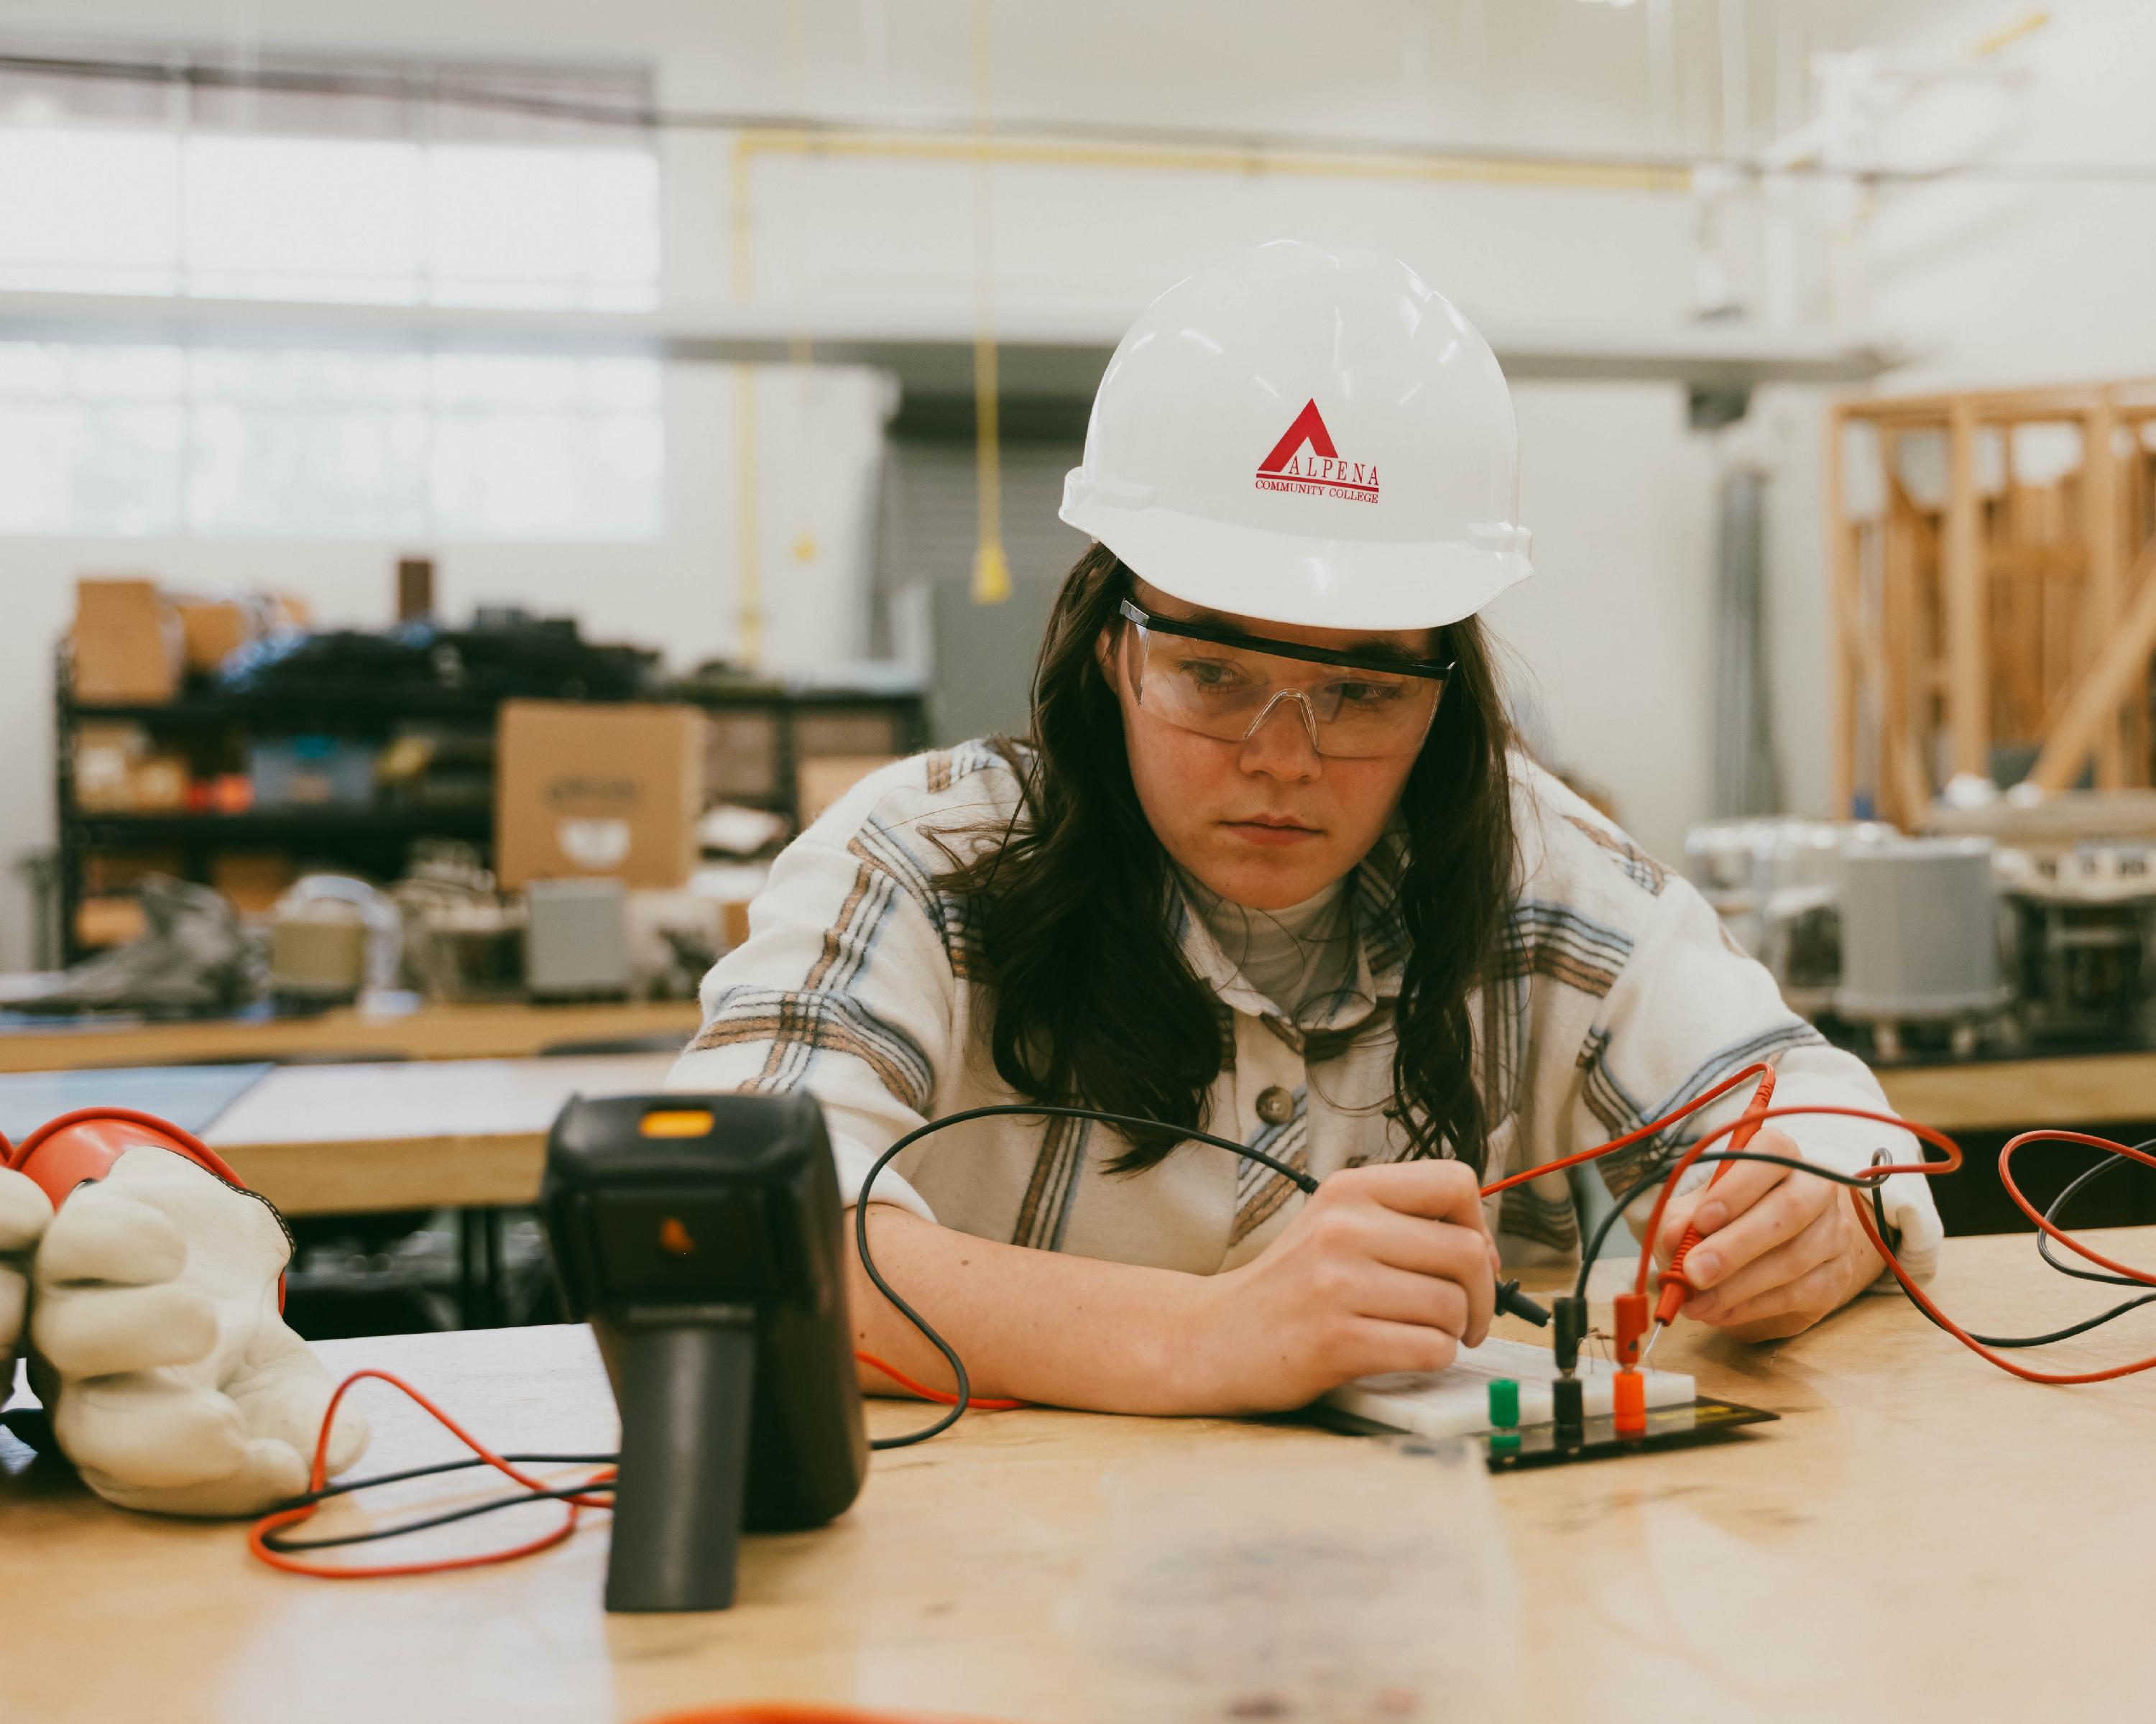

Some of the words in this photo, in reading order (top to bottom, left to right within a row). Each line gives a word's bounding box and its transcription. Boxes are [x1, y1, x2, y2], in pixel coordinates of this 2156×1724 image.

[1289, 455, 1379, 485] ALPENA
[1256, 480, 1324, 495] COMMUNITY
[1330, 489, 1378, 503] COLLEGE
